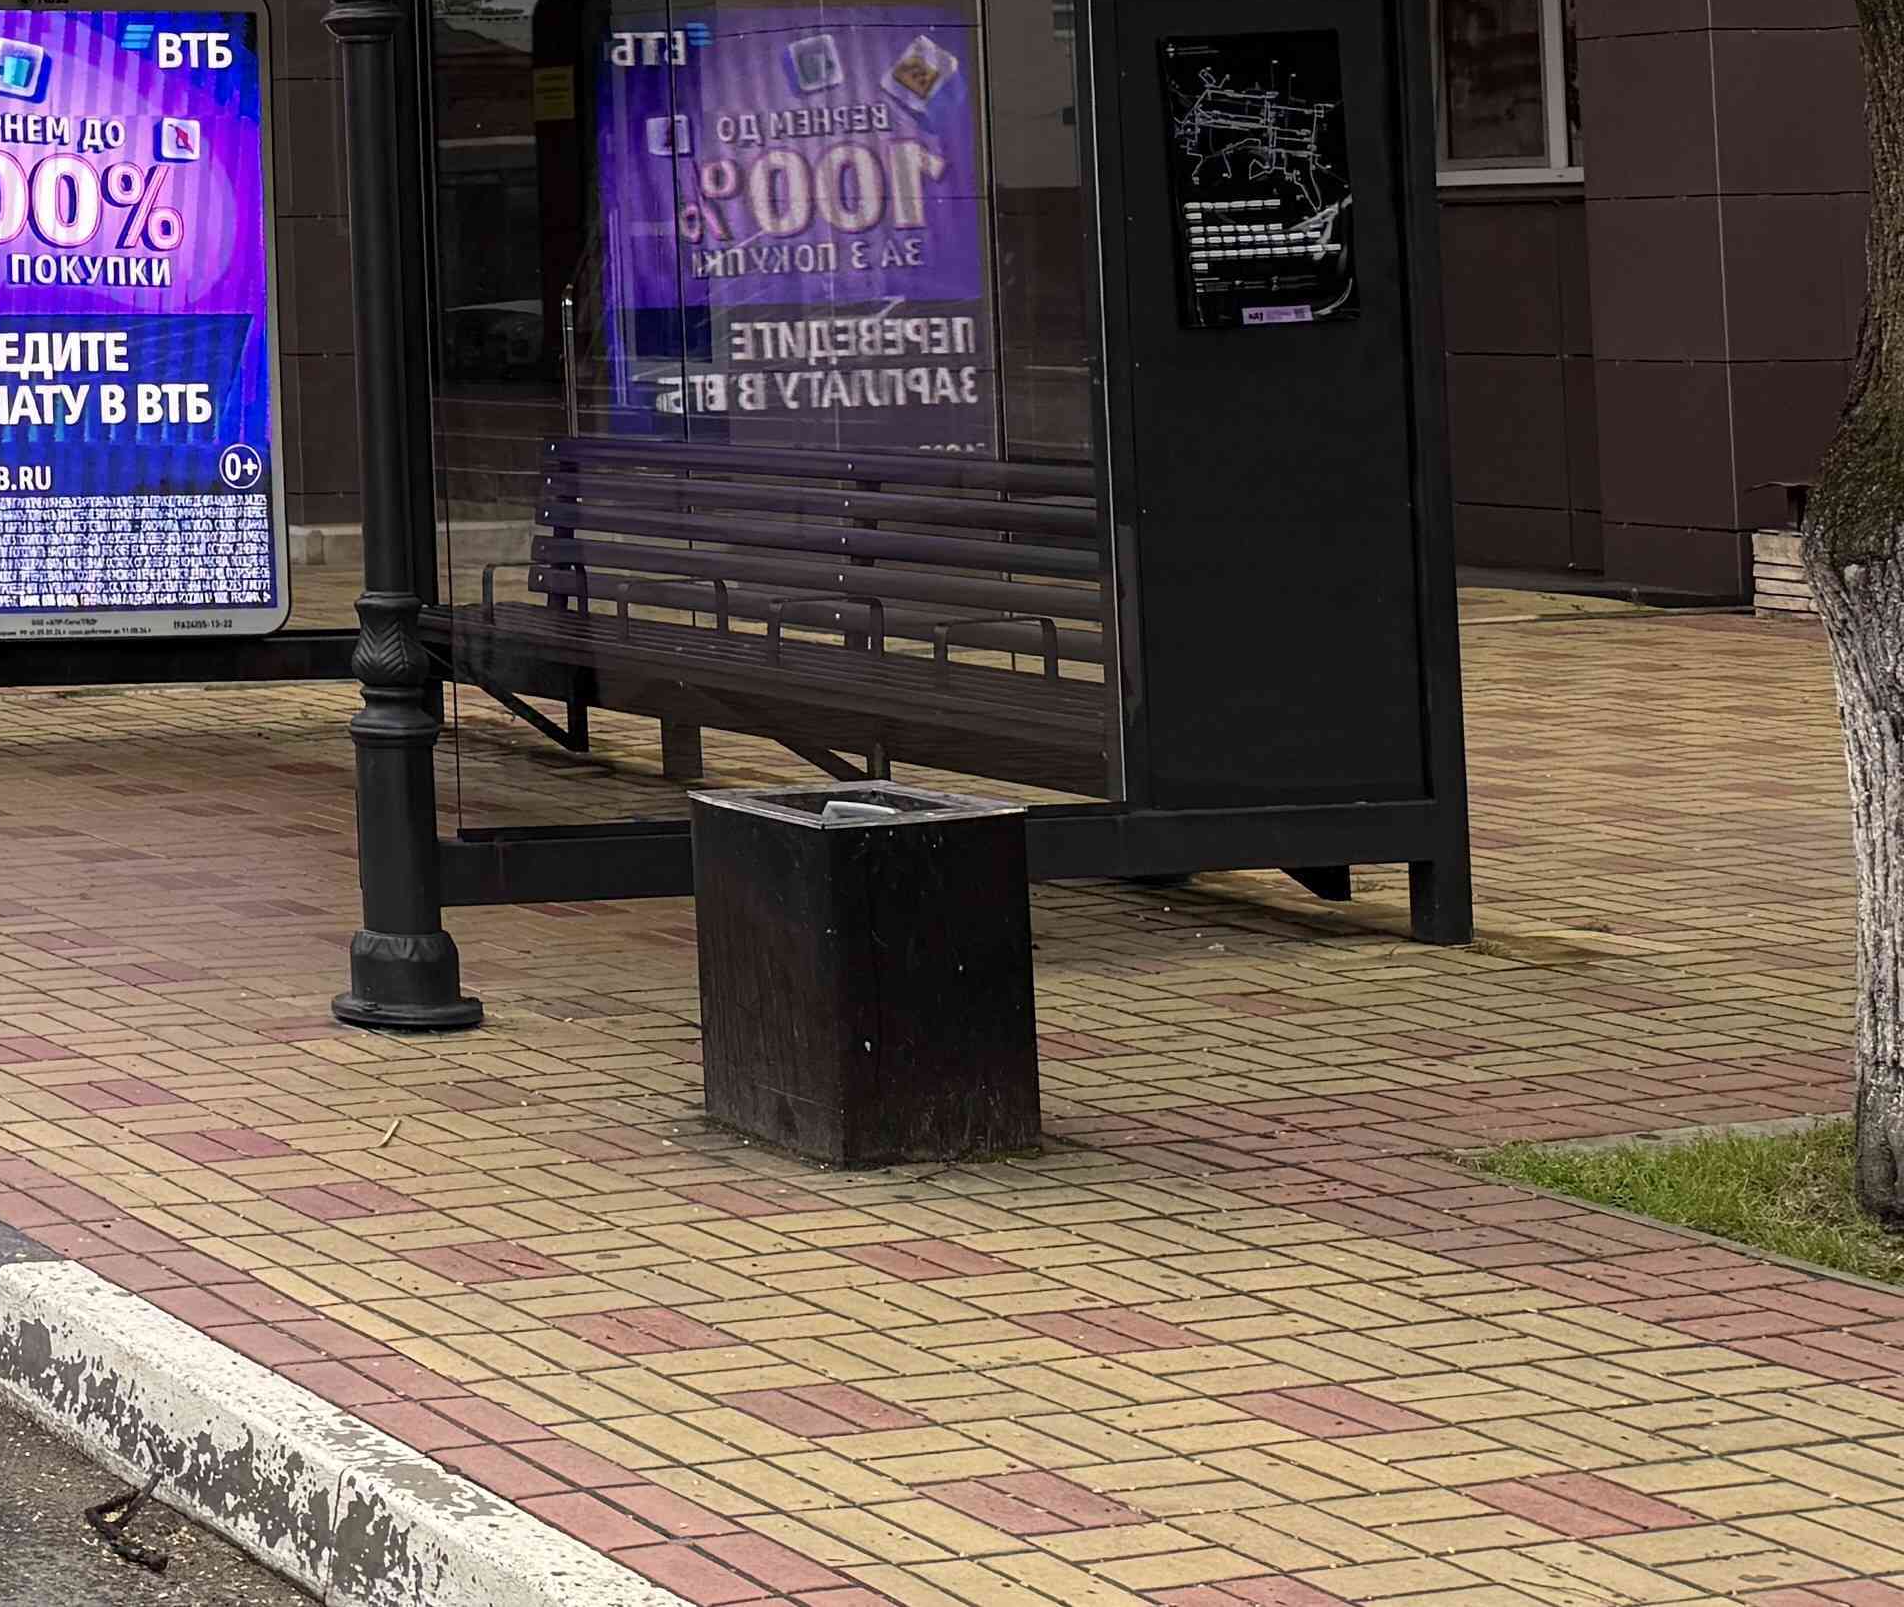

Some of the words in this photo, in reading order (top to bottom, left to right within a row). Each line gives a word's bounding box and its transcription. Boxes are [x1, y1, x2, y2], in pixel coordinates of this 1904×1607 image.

[158, 32, 233, 69] ВТБ
[79, 119, 126, 152] ДО
[8, 253, 173, 287] ПОКУПКИ
[100, 384, 127, 425] В
[136, 383, 213, 425] ВТБ
[224, 452, 259, 482] 0+
